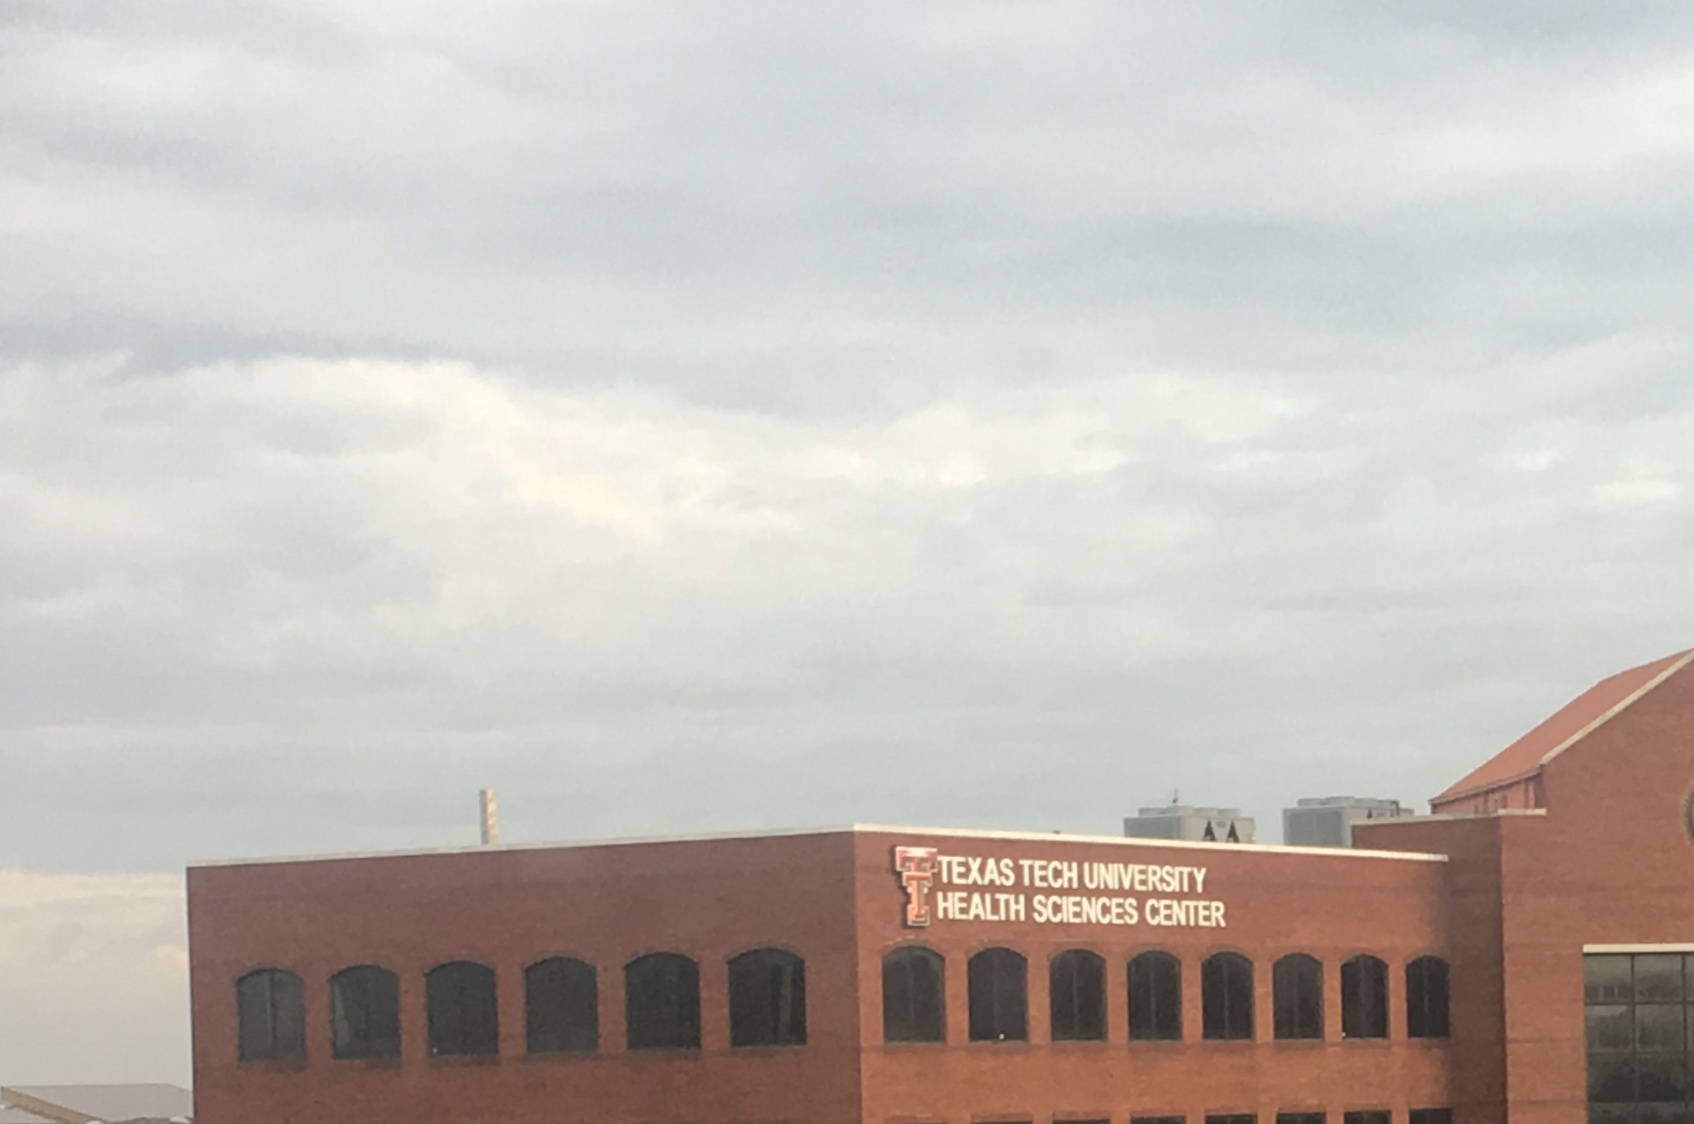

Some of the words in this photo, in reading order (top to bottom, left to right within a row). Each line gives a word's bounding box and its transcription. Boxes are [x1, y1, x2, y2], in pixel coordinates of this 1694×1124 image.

[938, 855, 1015, 886] TEXAS
[1020, 859, 1079, 888] TECH
[1084, 863, 1207, 893] UNIVERSITY
[937, 892, 1025, 921] HEALTH
[1033, 895, 1138, 925] SCIENCES
[1145, 899, 1226, 927] CENTER
